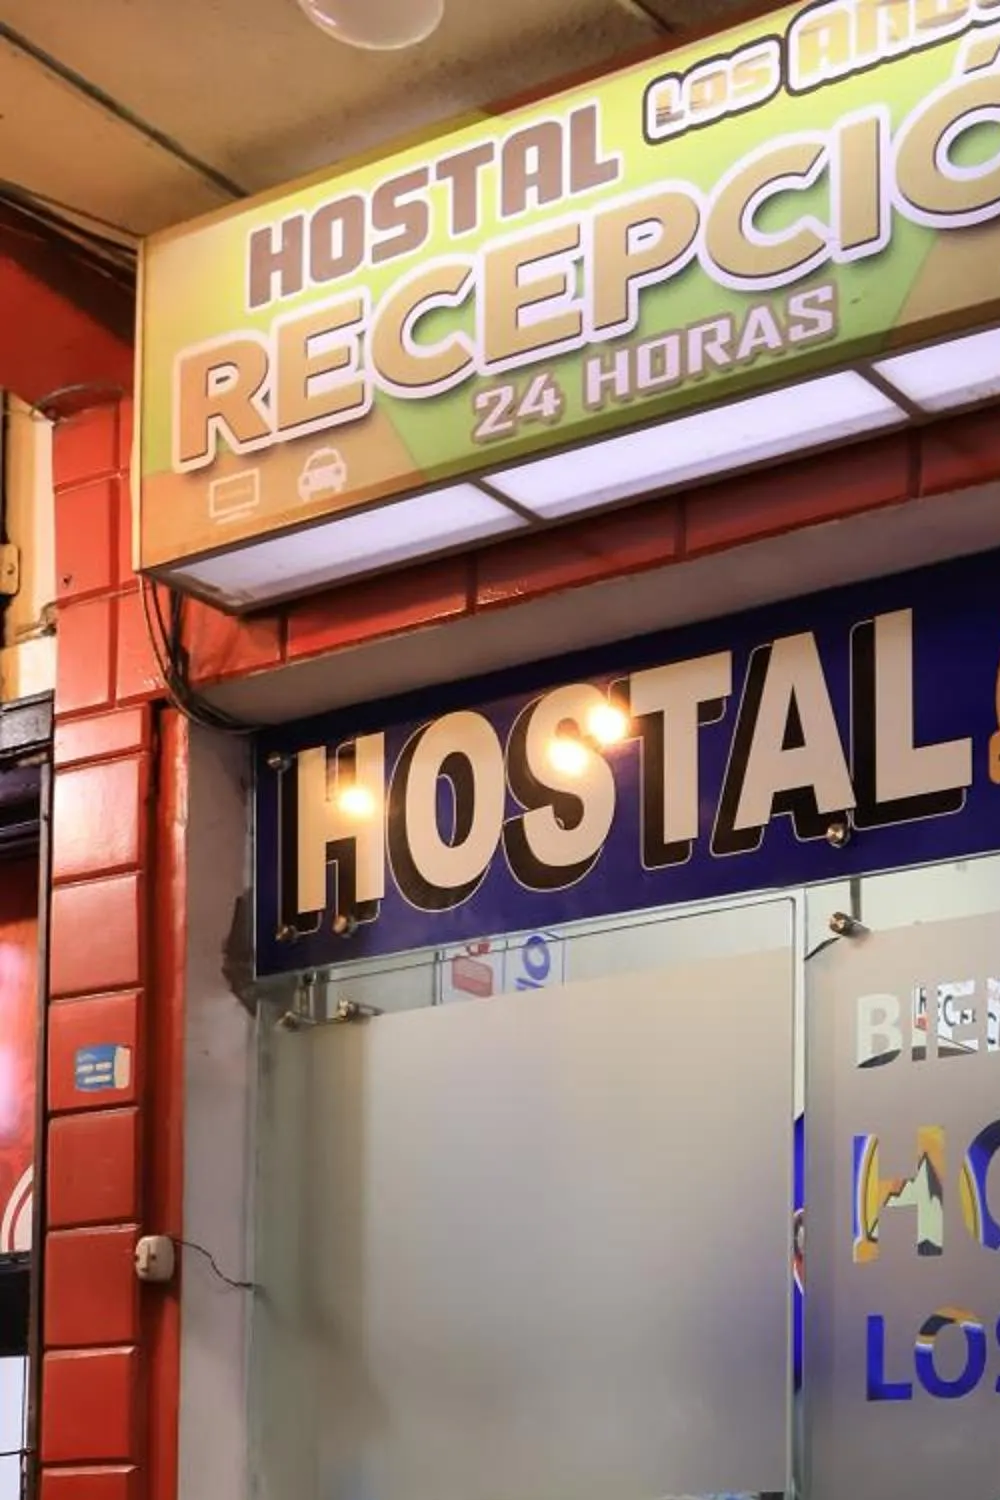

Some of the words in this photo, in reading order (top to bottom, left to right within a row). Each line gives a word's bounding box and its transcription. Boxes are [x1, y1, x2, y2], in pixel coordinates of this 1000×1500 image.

[248, 103, 619, 308] HOSTAL
[648, 40, 780, 142] LOS
[475, 374, 561, 440] 24
[586, 285, 840, 406] HORAS
[282, 607, 973, 922] HOSTAL
